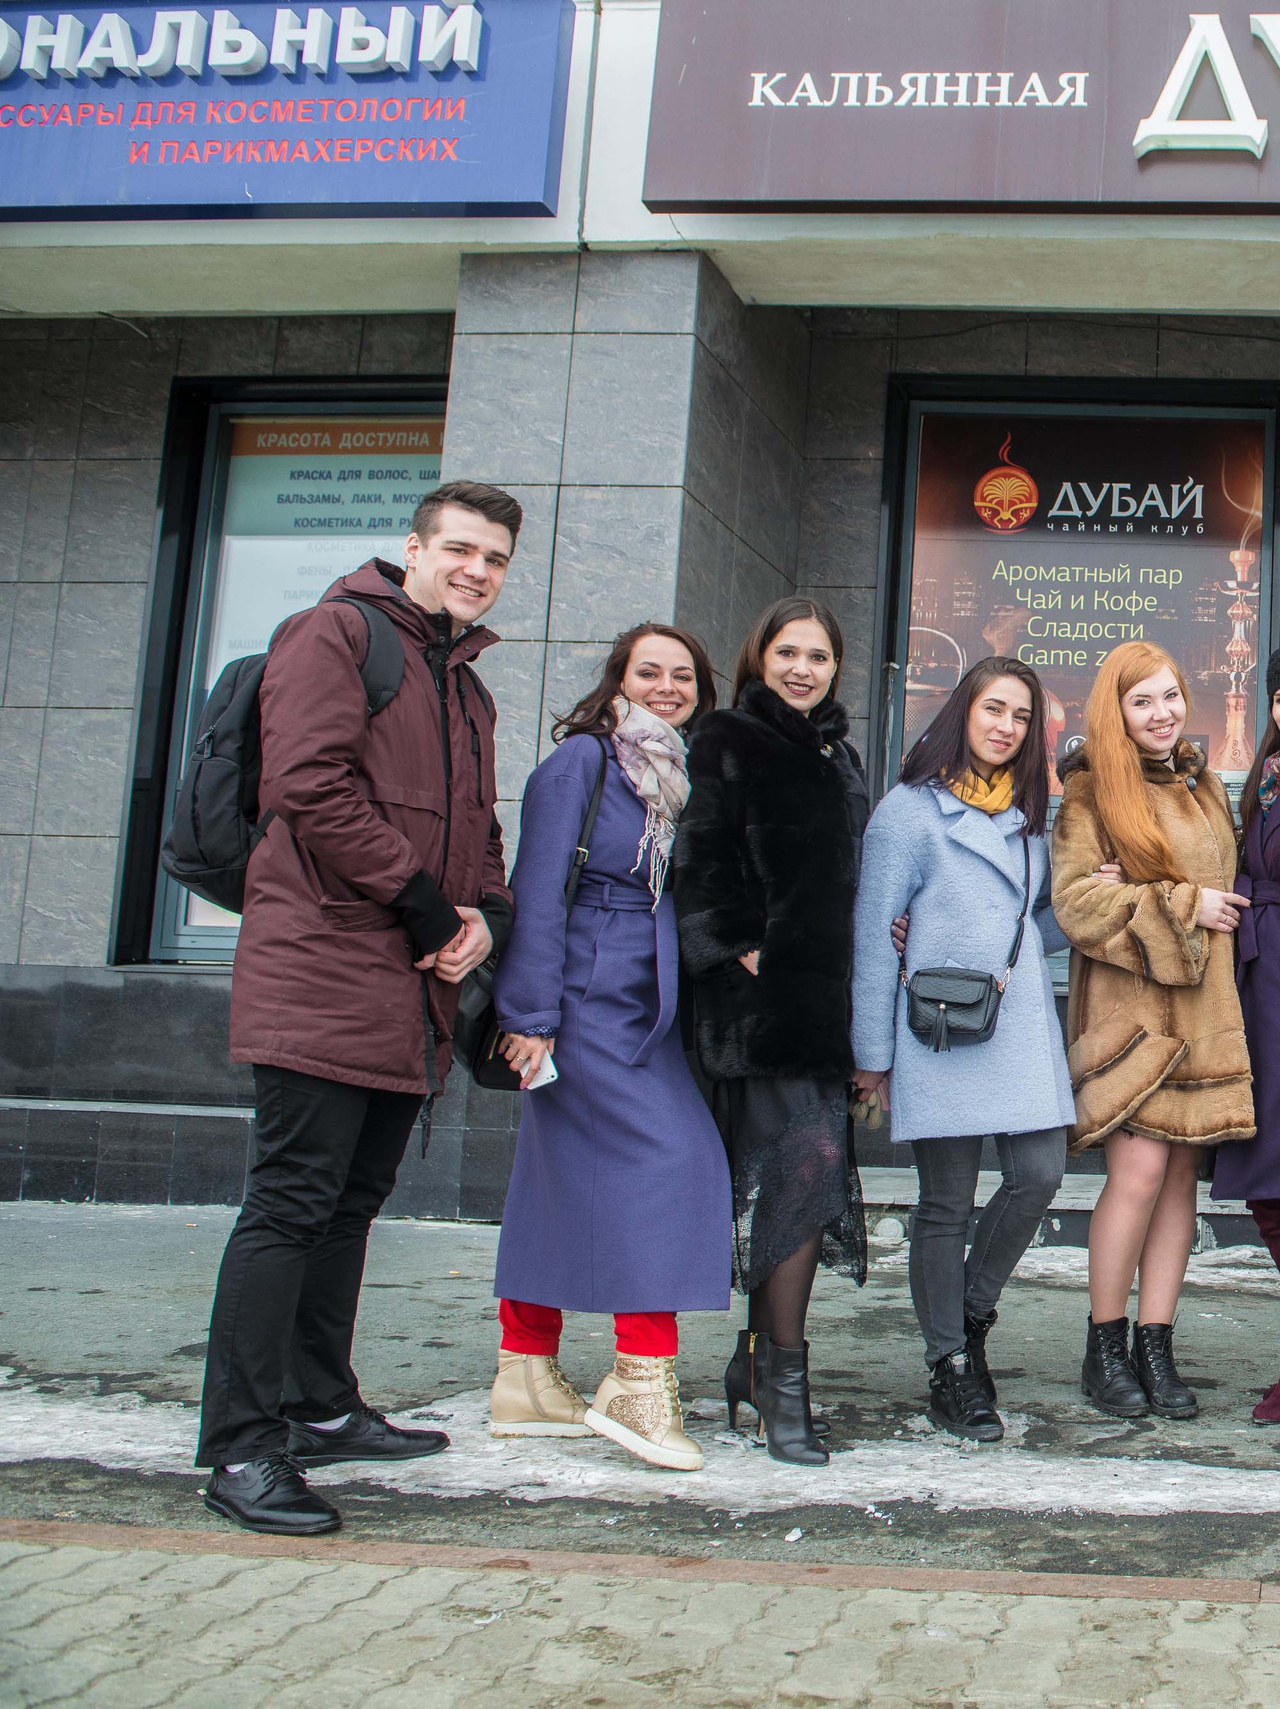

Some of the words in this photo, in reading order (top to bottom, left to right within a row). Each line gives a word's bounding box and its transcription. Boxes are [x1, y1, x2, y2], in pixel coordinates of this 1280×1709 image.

[748, 71, 1090, 107] КАЛЬЯННАЯ
[0, 102, 124, 127] ССУАРЫ
[130, 101, 197, 130] ДЛЯ
[205, 96, 466, 125] КОСМЕТОЛОГИИ
[128, 140, 150, 165] И
[158, 136, 460, 165] ПАРИКМАХЕРСКИХ
[256, 432, 332, 448] КРАСОТА
[338, 431, 431, 449] ДОСТУПНА
[289, 469, 332, 481] КРАСКА
[337, 469, 363, 483] ДЛЯ
[367, 469, 412, 482] ВОЛОС,
[277, 493, 345, 506] БАЛЬЗАМЫ,
[351, 493, 386, 506] ЛАКИ,
[1047, 475, 1205, 519] ДУБАЙ
[293, 517, 363, 529] КОСМЕТИКА
[367, 517, 393, 530] ДЛЯ
[1047, 521, 1134, 533] чайный
[1151, 522, 1204, 535] клуб
[992, 559, 1130, 584] Ароматный
[1139, 566, 1183, 590] пар
[1016, 588, 1062, 610] Чай
[1071, 591, 1084, 610] и
[1093, 589, 1158, 617] Кофе
[1027, 616, 1144, 641] Сладости
[1017, 643, 1088, 667] Game
